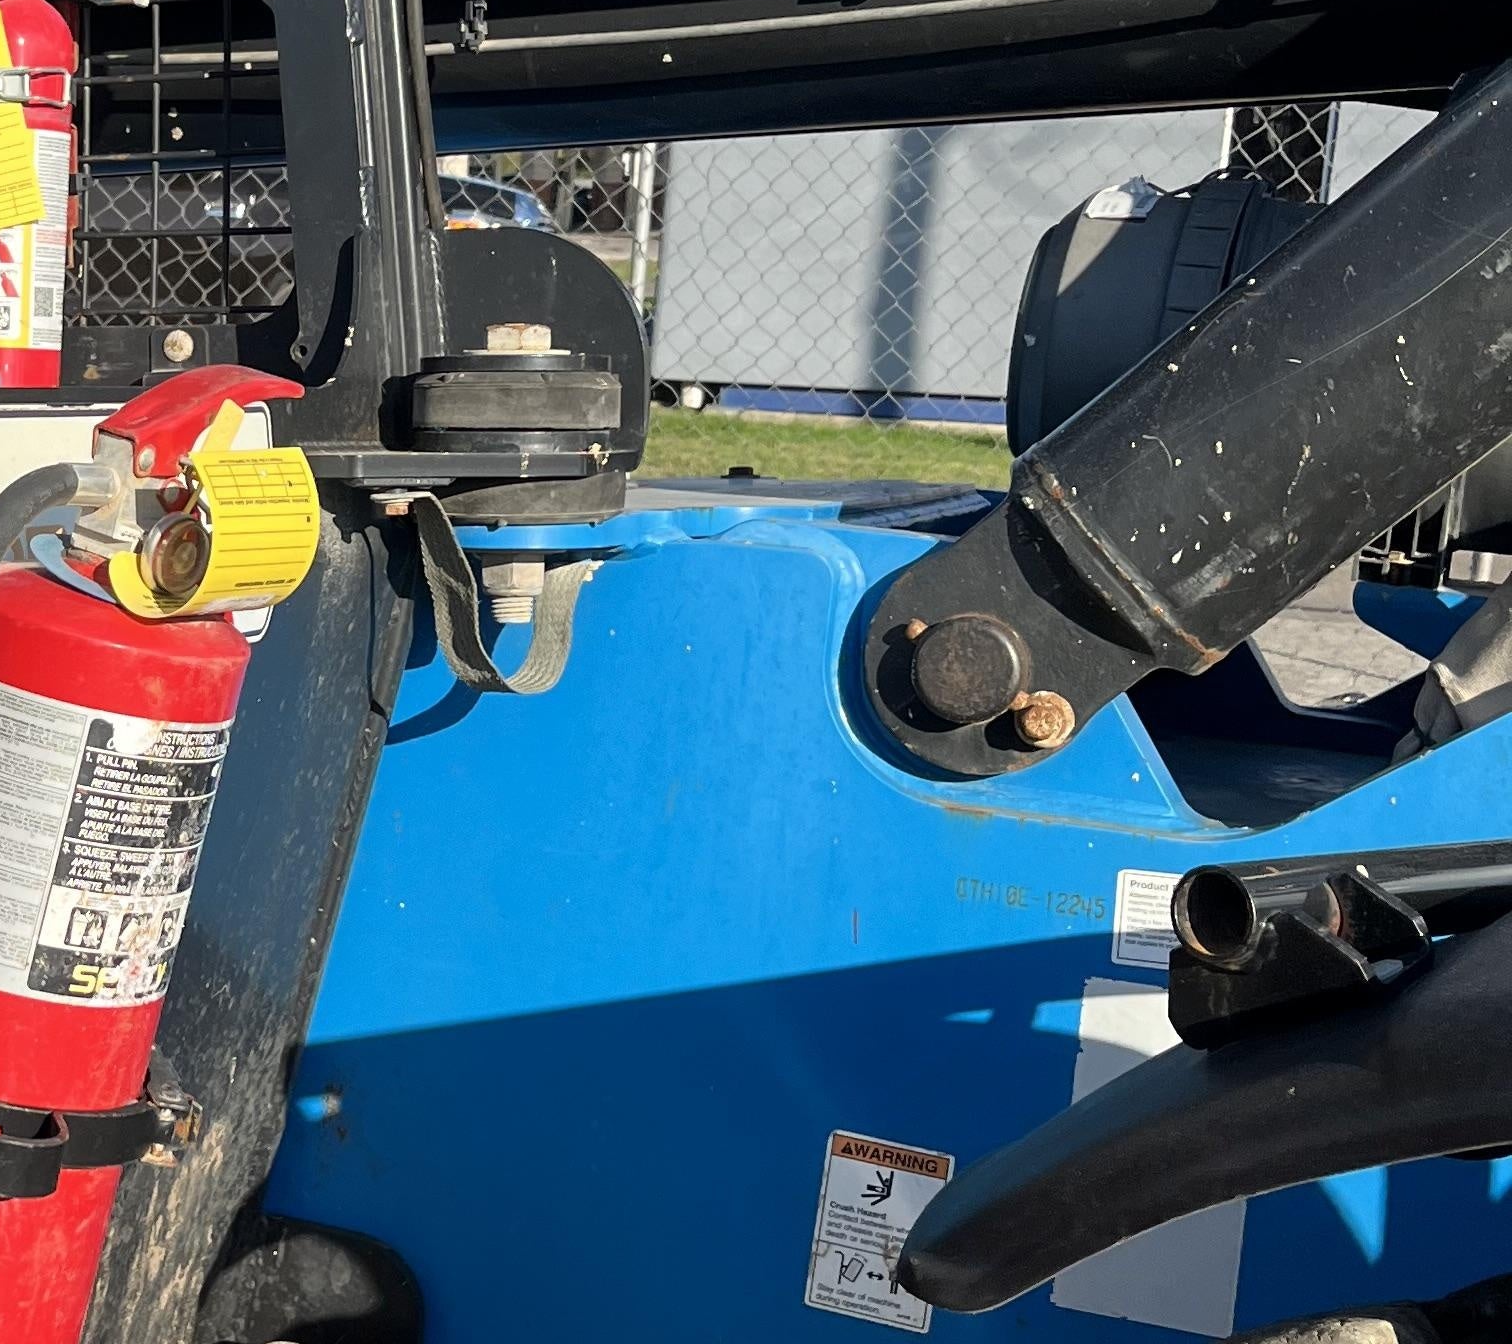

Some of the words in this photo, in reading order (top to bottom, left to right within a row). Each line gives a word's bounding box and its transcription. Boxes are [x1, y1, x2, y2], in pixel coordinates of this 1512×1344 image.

[96, 753, 121, 768] PULL
[121, 758, 138, 771] PIN.
[93, 766, 129, 781] RETIRER
[130, 771, 141, 783] LA
[91, 777, 122, 792] RETIRE
[122, 783, 133, 794] EL
[86, 794, 104, 808] AIM
[104, 797, 117, 809] AT
[117, 799, 142, 813] BASE
[142, 802, 155, 814] OF
[85, 807, 109, 821] VISER
[109, 811, 121, 822] LA
[120, 814, 143, 826] BASE
[142, 815, 154, 826] DU
[80, 820, 114, 834] APUNTE
[121, 826, 133, 836] LA
[132, 827, 151, 838] BASE
[151, 828, 166, 839] DEL
[1130, 879, 1170, 893] Product
[854, 1143, 939, 1174] WARNING
[828, 1210, 859, 1223] Contact
[830, 1200, 855, 1214] Crush
[856, 1207, 887, 1221] Hazard
[826, 1220, 843, 1230] and
[825, 1228, 848, 1241] death
